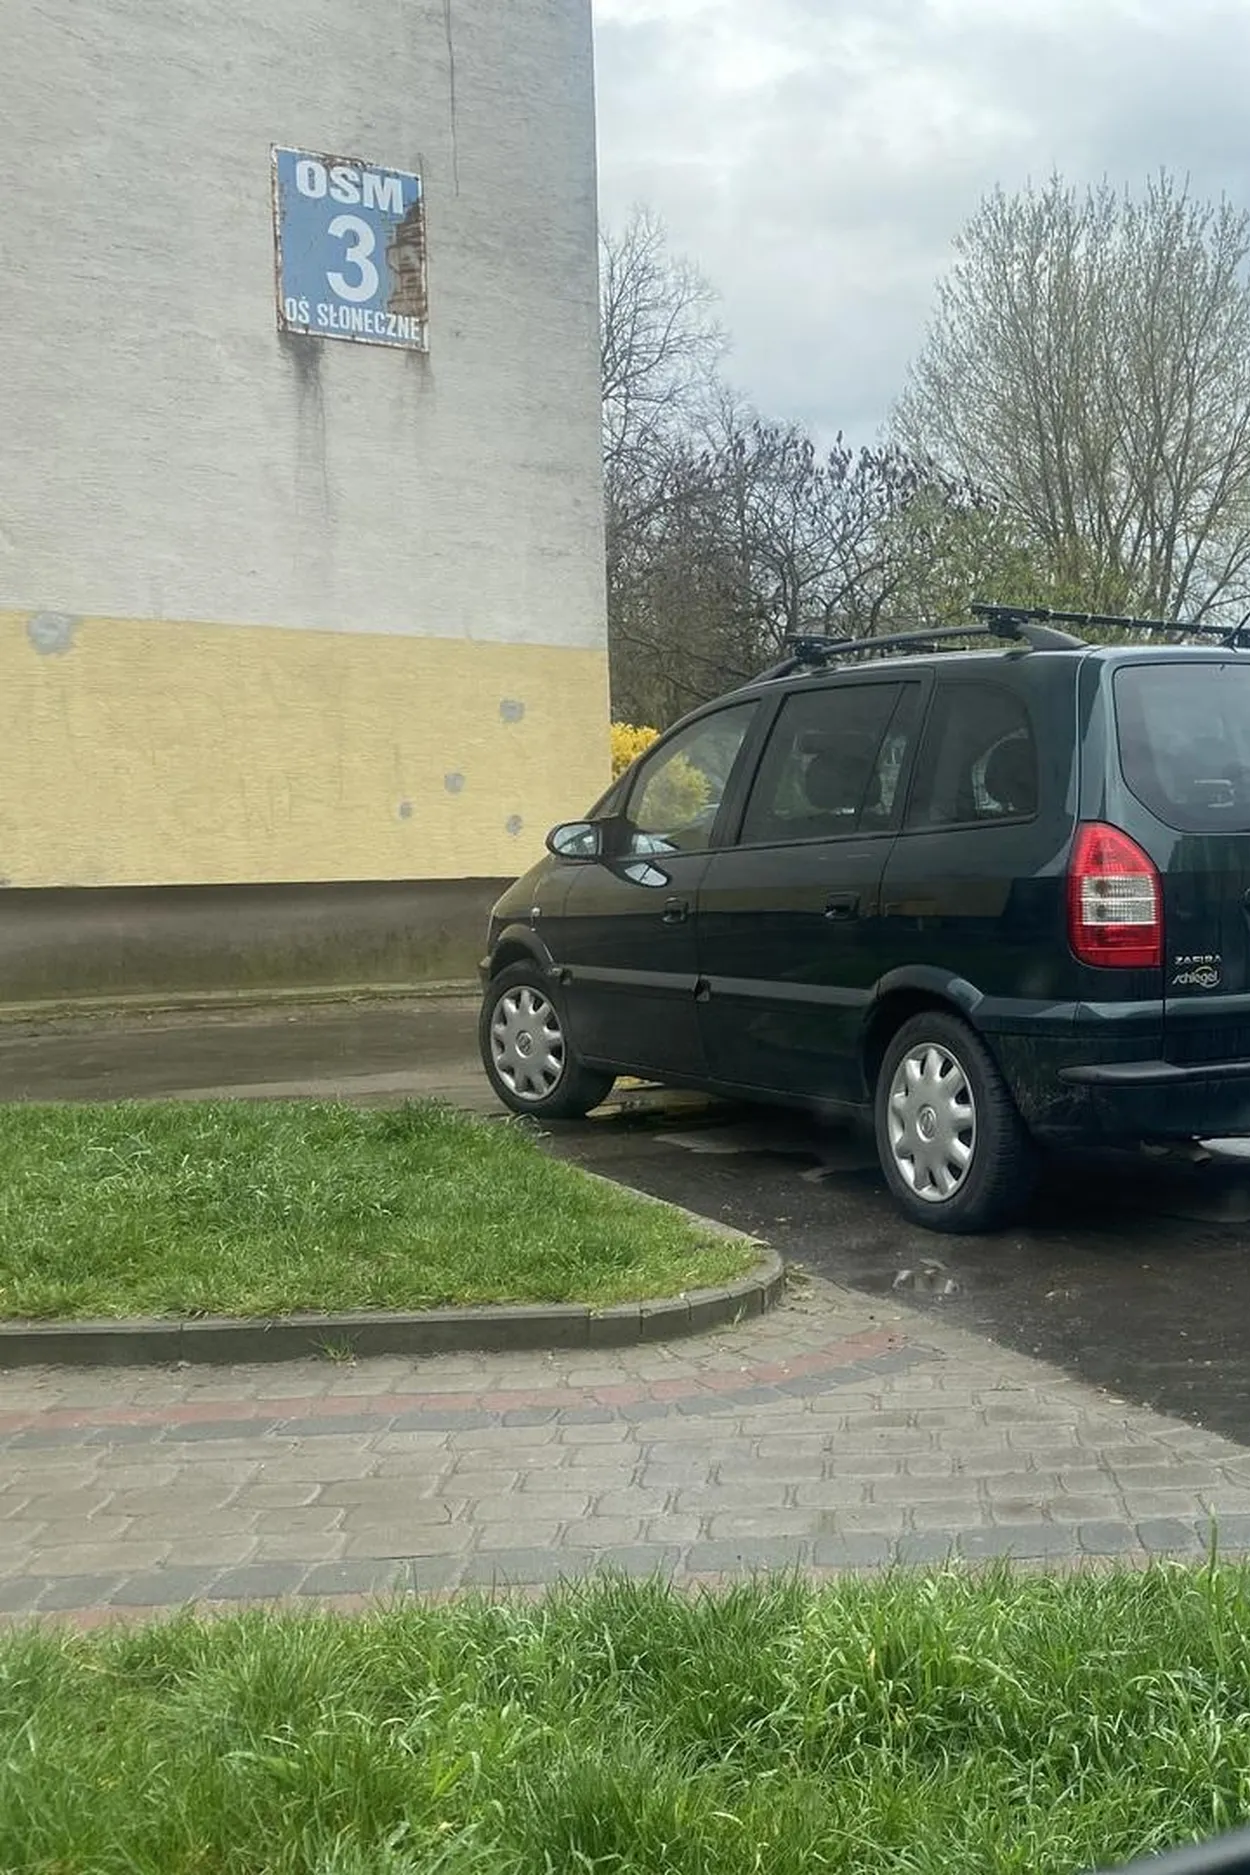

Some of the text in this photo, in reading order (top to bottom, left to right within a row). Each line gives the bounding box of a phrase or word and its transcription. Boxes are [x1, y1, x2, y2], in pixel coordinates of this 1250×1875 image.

[296, 160, 404, 214] OSM
[326, 214, 379, 302] 3
[285, 296, 420, 340] OŚ SŁONECZNE
